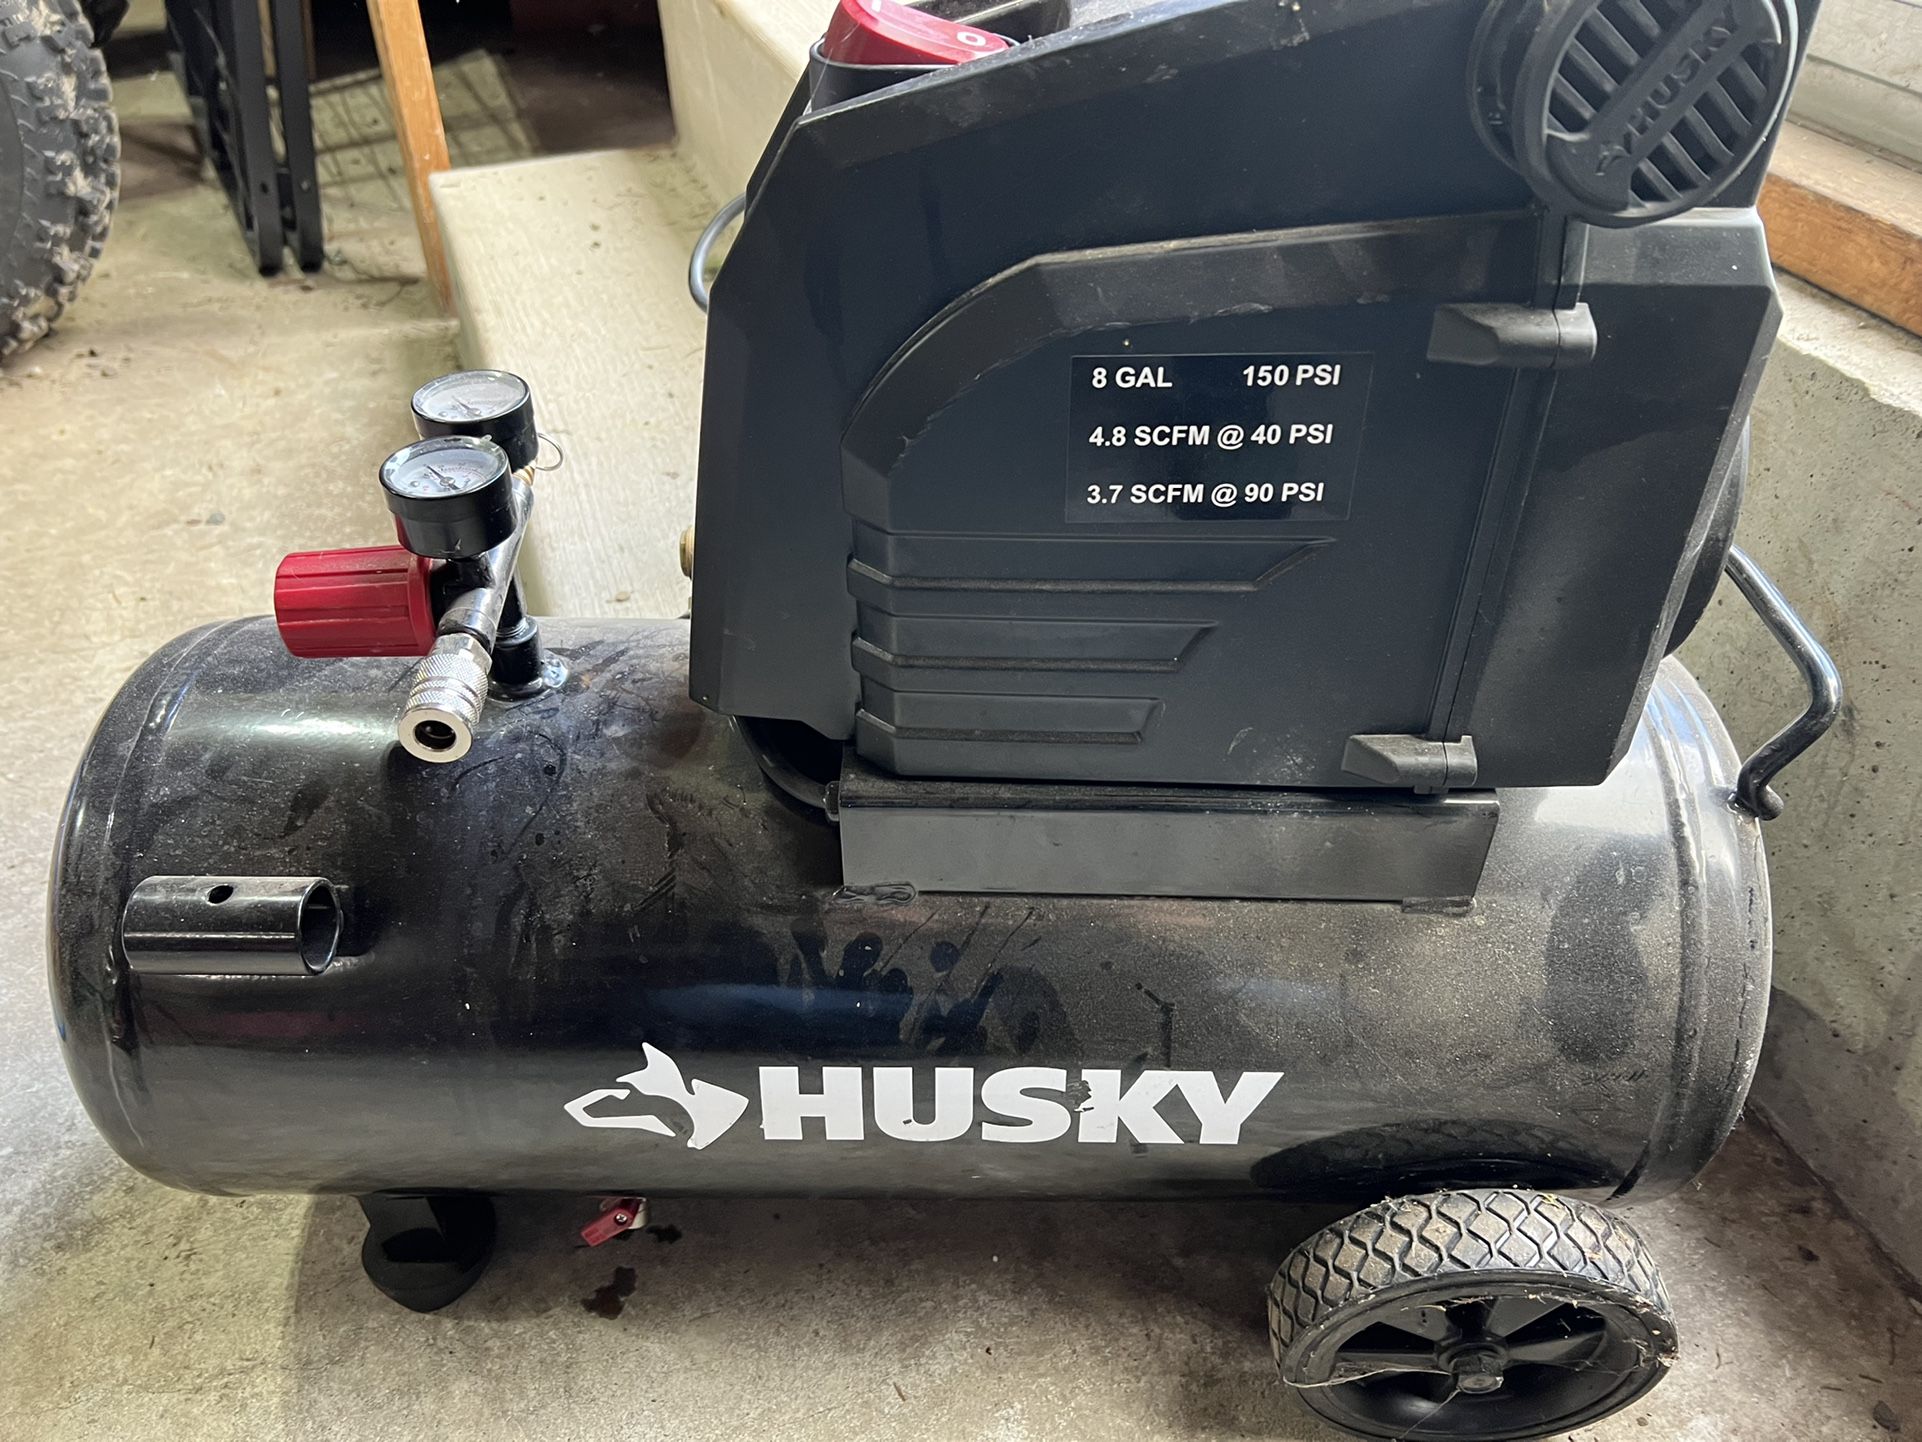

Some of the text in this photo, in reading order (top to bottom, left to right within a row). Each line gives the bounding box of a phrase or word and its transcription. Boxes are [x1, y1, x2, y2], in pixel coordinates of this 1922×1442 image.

[1622, 4, 1737, 154] HUSKY
[1092, 365, 1340, 388] 8 GAL 150 PSI
[1089, 424, 1333, 449] 4.8 SCFM @ 40 PSI
[1087, 483, 1324, 507] 3.7 SCFM @ 90 PSI
[760, 1067, 1284, 1144] HUSKY
